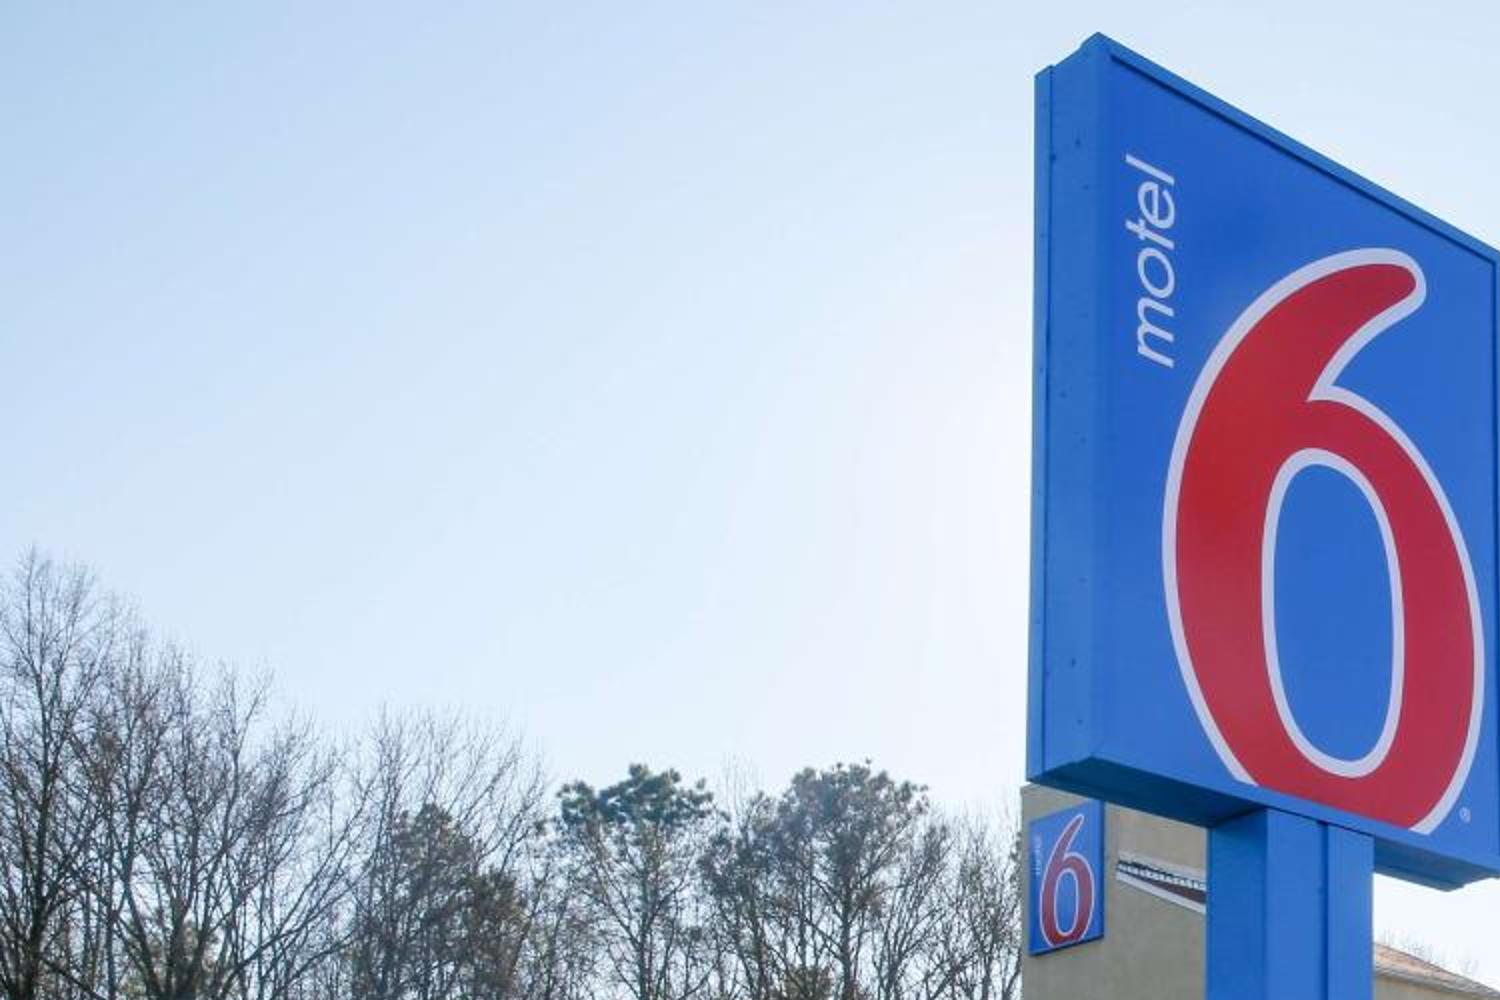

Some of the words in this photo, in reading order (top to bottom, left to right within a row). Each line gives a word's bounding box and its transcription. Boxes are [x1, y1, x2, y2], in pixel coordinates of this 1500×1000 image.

[1125, 153, 1175, 368] motel
[1162, 248, 1488, 836] 6
[1040, 813, 1095, 948] 6
